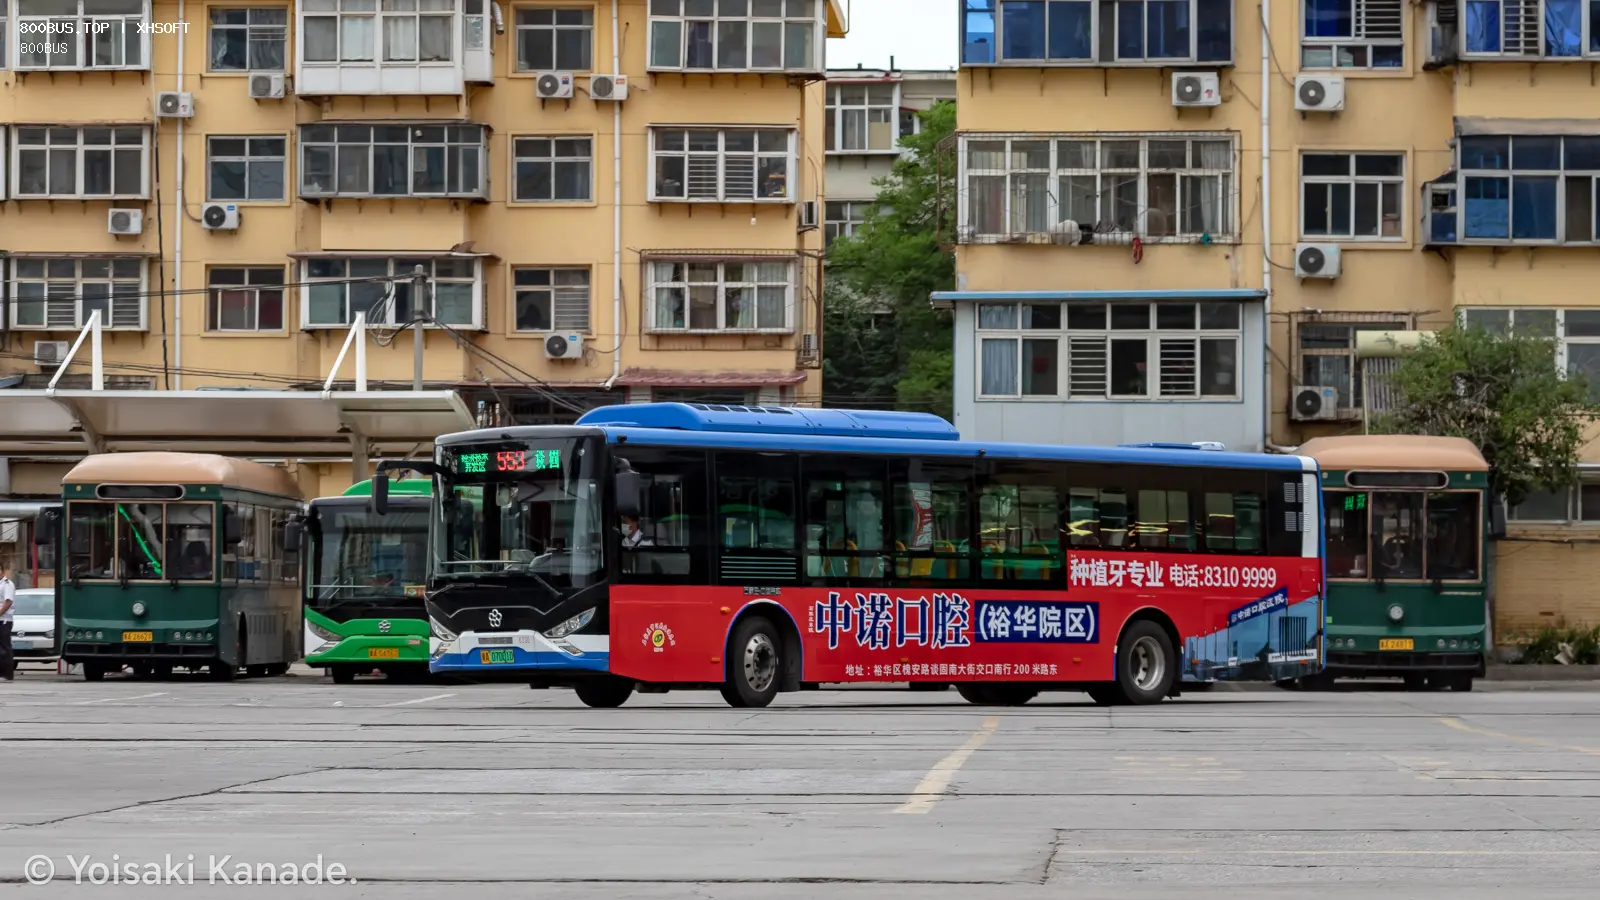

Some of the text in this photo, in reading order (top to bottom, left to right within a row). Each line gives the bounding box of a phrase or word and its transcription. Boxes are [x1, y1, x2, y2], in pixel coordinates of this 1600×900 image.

[496, 450, 525, 471] 553
[1070, 557, 1165, 588] 种植牙专业
[1241, 566, 1277, 589] 9999
[815, 591, 971, 650] 中诺口腔
[1013, 663, 1030, 676] 200
[1031, 662, 1058, 677] 米路东
